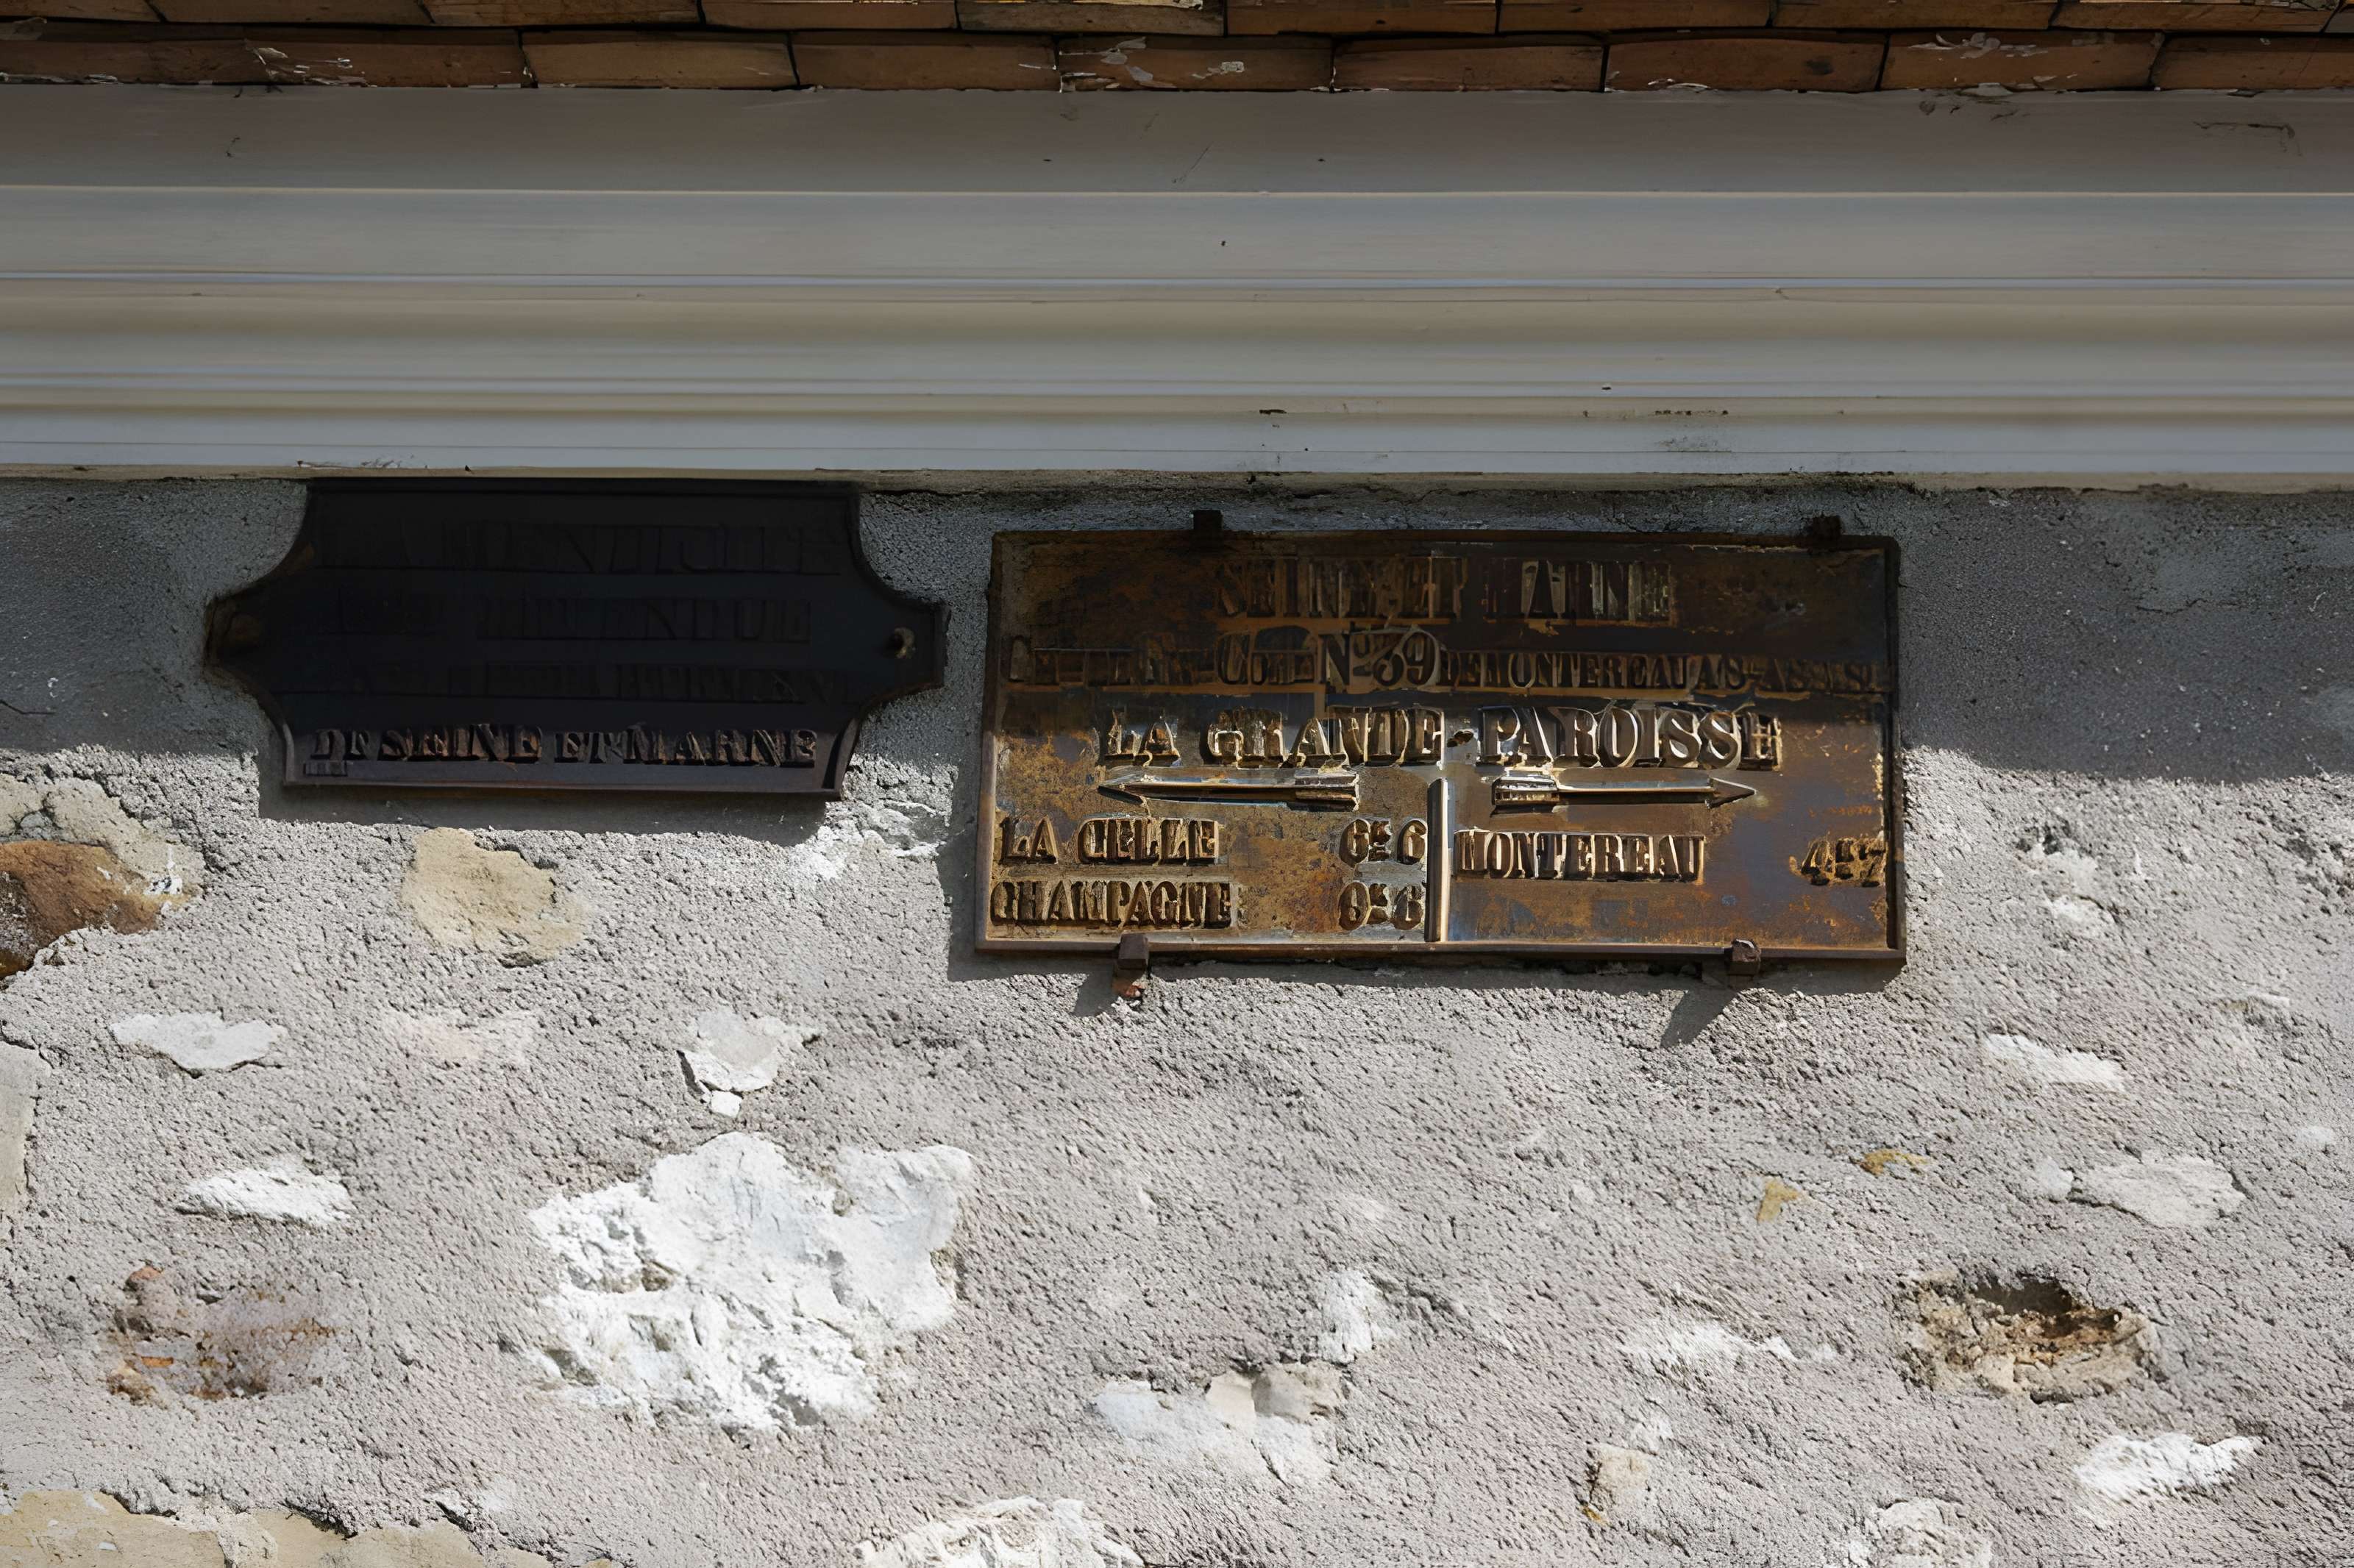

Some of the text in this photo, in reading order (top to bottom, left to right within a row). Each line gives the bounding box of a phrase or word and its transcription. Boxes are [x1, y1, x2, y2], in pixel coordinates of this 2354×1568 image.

[1101, 705, 1183, 767] LA
[999, 815, 1059, 866] LA
[1077, 816, 1221, 868] CELLE
[1453, 830, 1705, 885] MONTEREAU
[989, 879, 1236, 930] CHAMPAGNE
